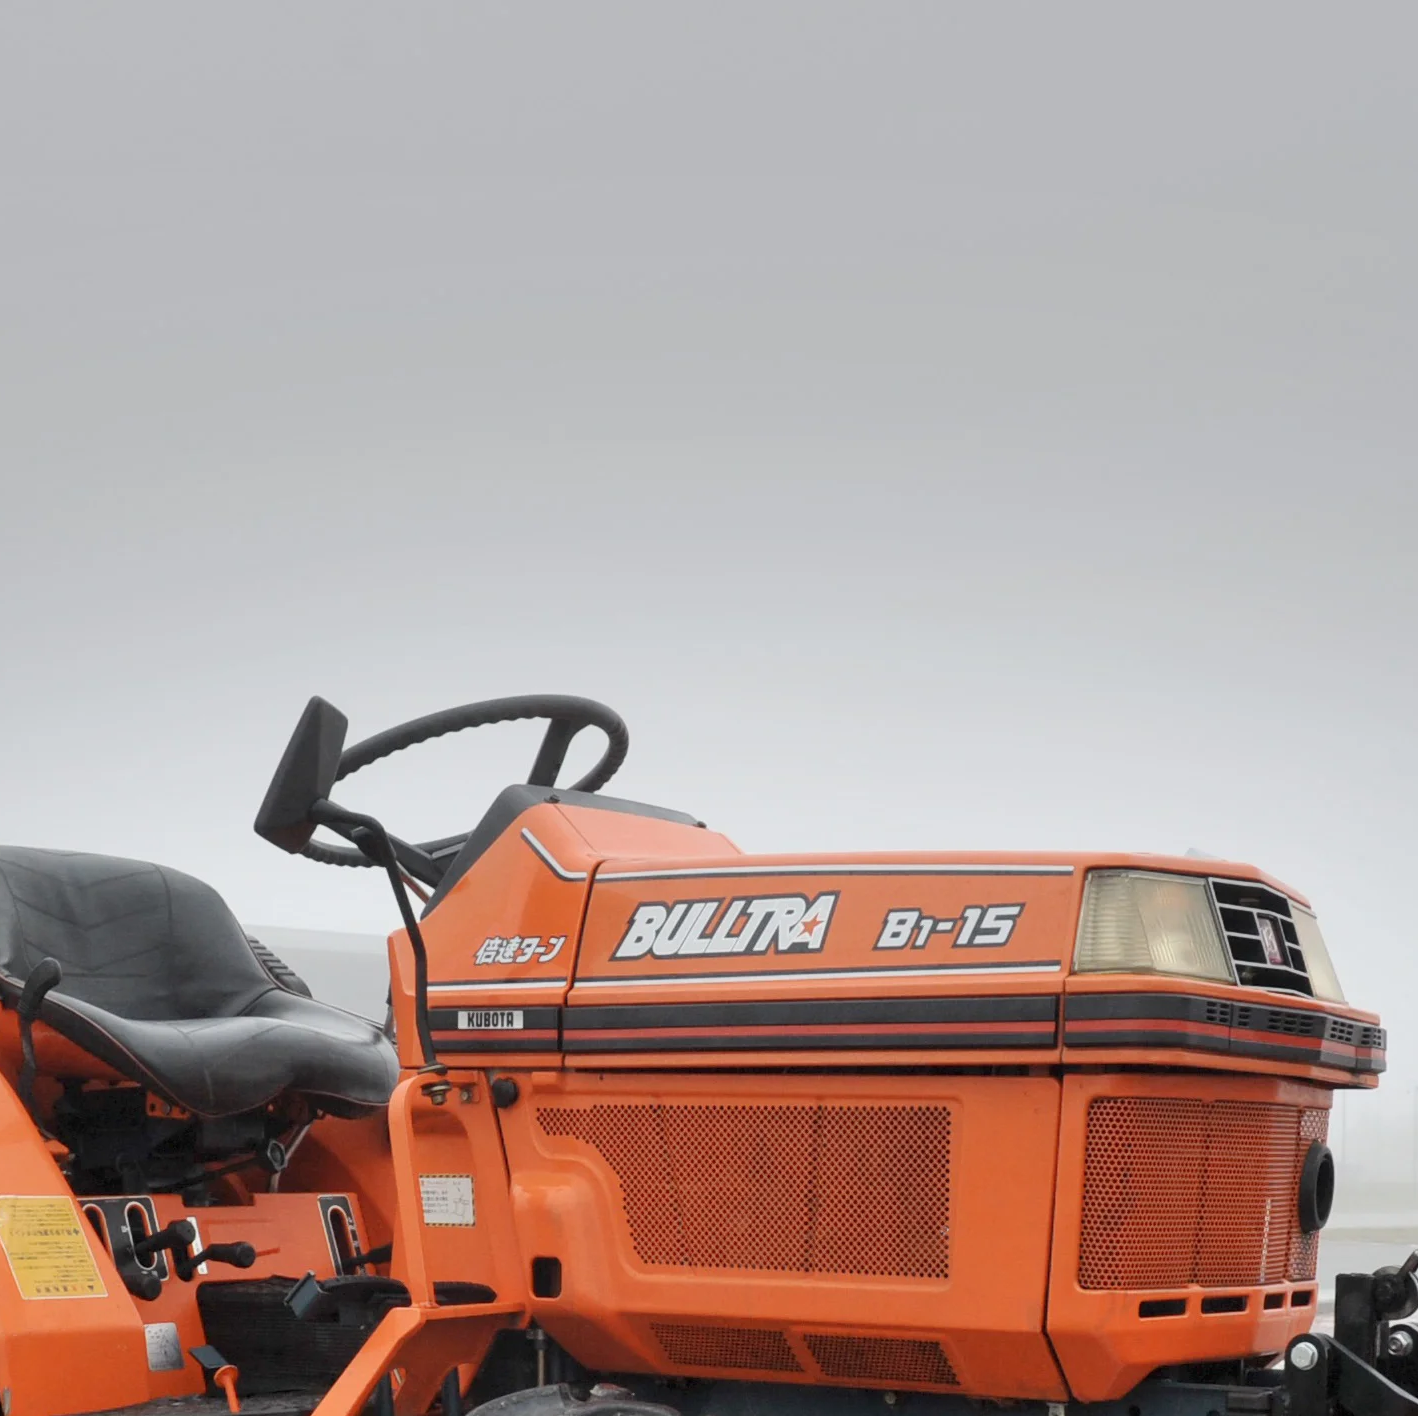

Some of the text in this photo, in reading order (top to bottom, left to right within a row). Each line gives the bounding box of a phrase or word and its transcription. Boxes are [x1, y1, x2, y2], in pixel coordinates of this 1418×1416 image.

[612, 892, 1024, 959] BULLTRA B1-15
[474, 935, 567, 965] 倍速ターン
[467, 1011, 514, 1028] KUBOTA
